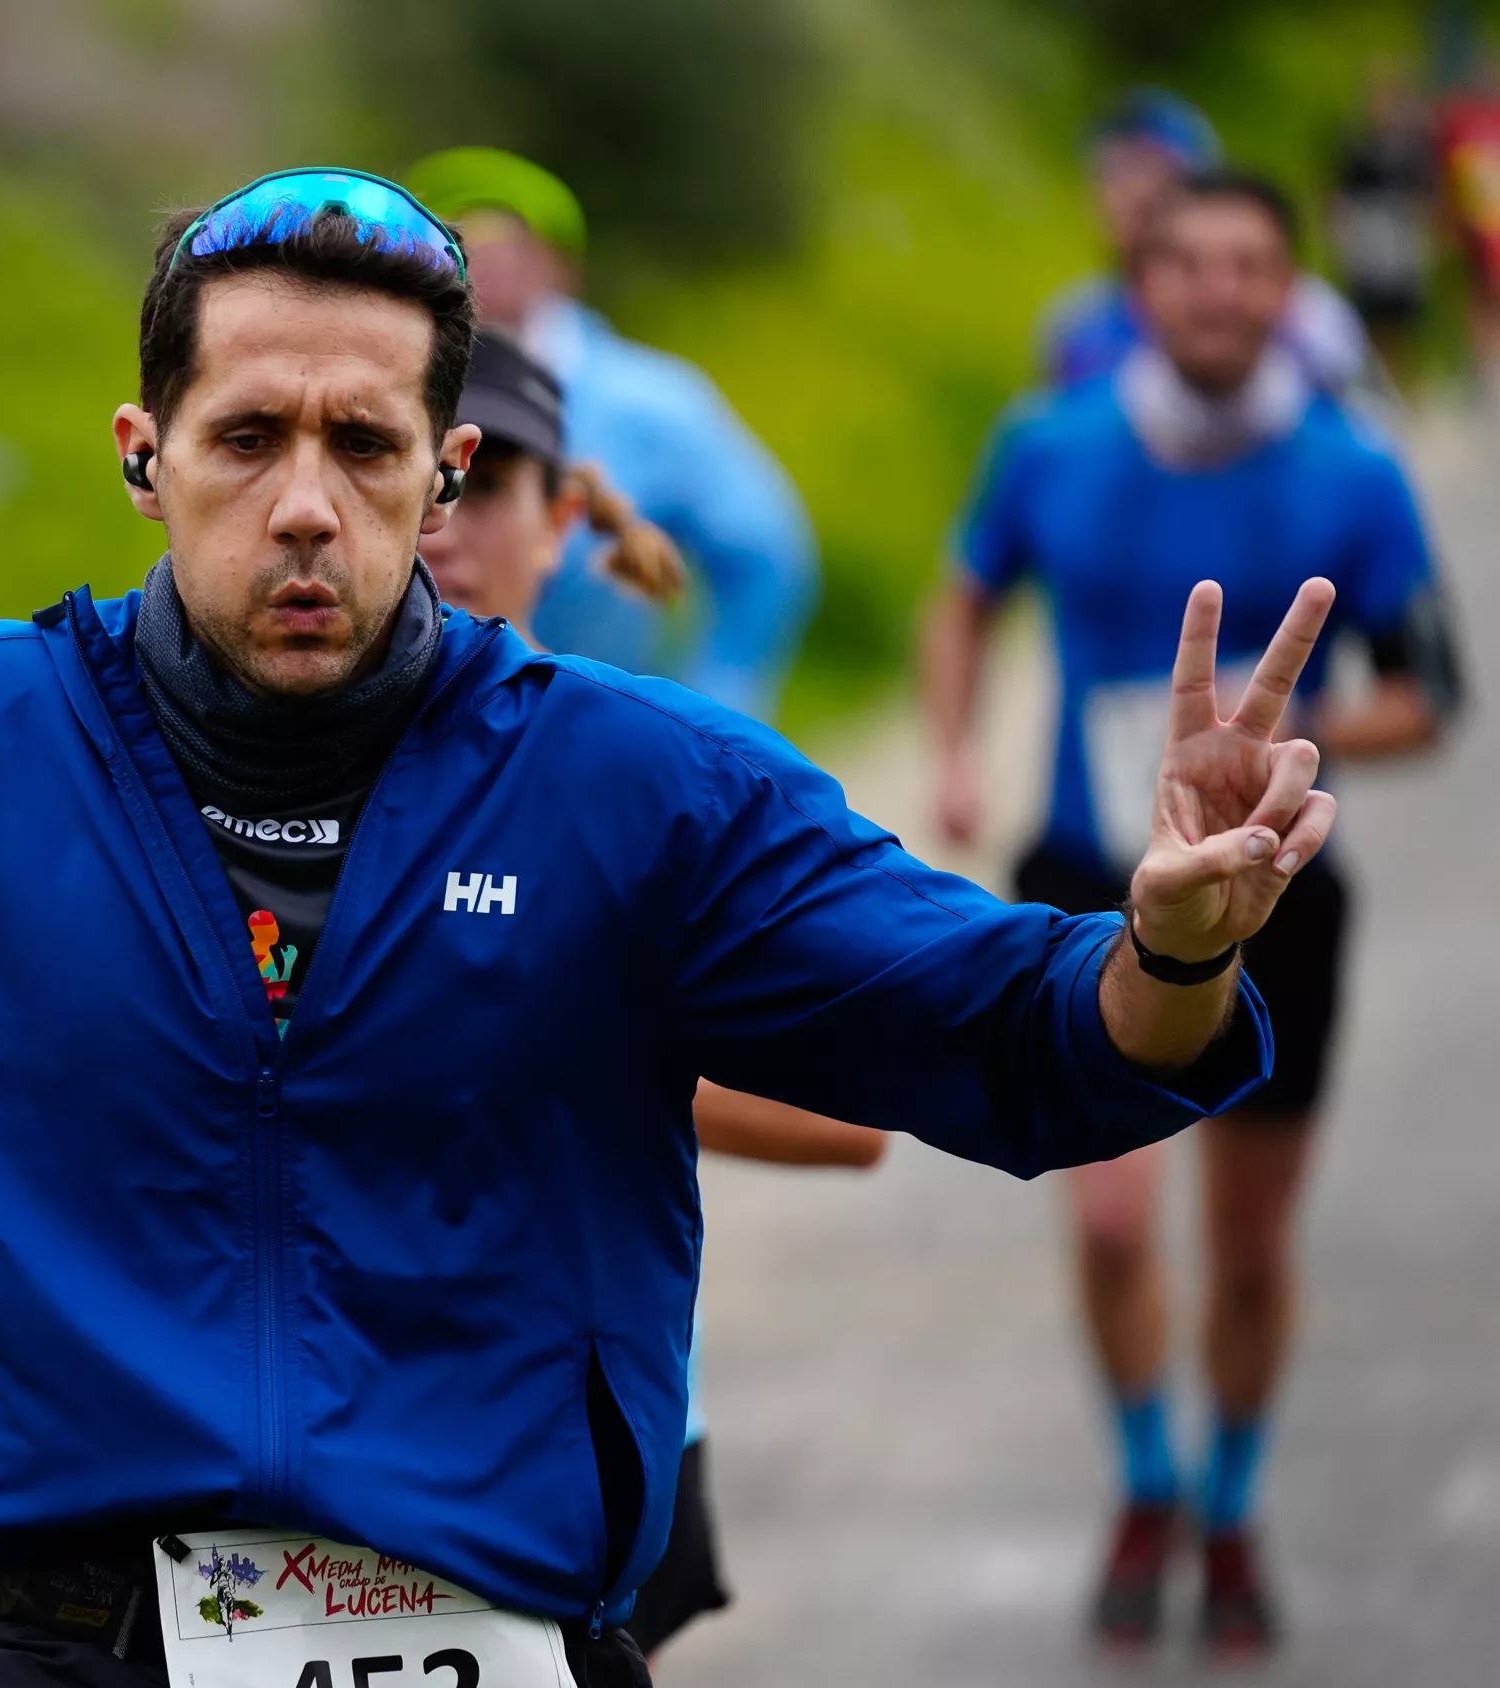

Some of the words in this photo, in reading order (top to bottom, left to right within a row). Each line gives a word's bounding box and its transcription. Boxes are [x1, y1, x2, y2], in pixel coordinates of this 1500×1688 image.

[444, 872, 517, 915] HH
[325, 1581, 457, 1618] LUCENA
[374, 1576, 387, 1586] DE
